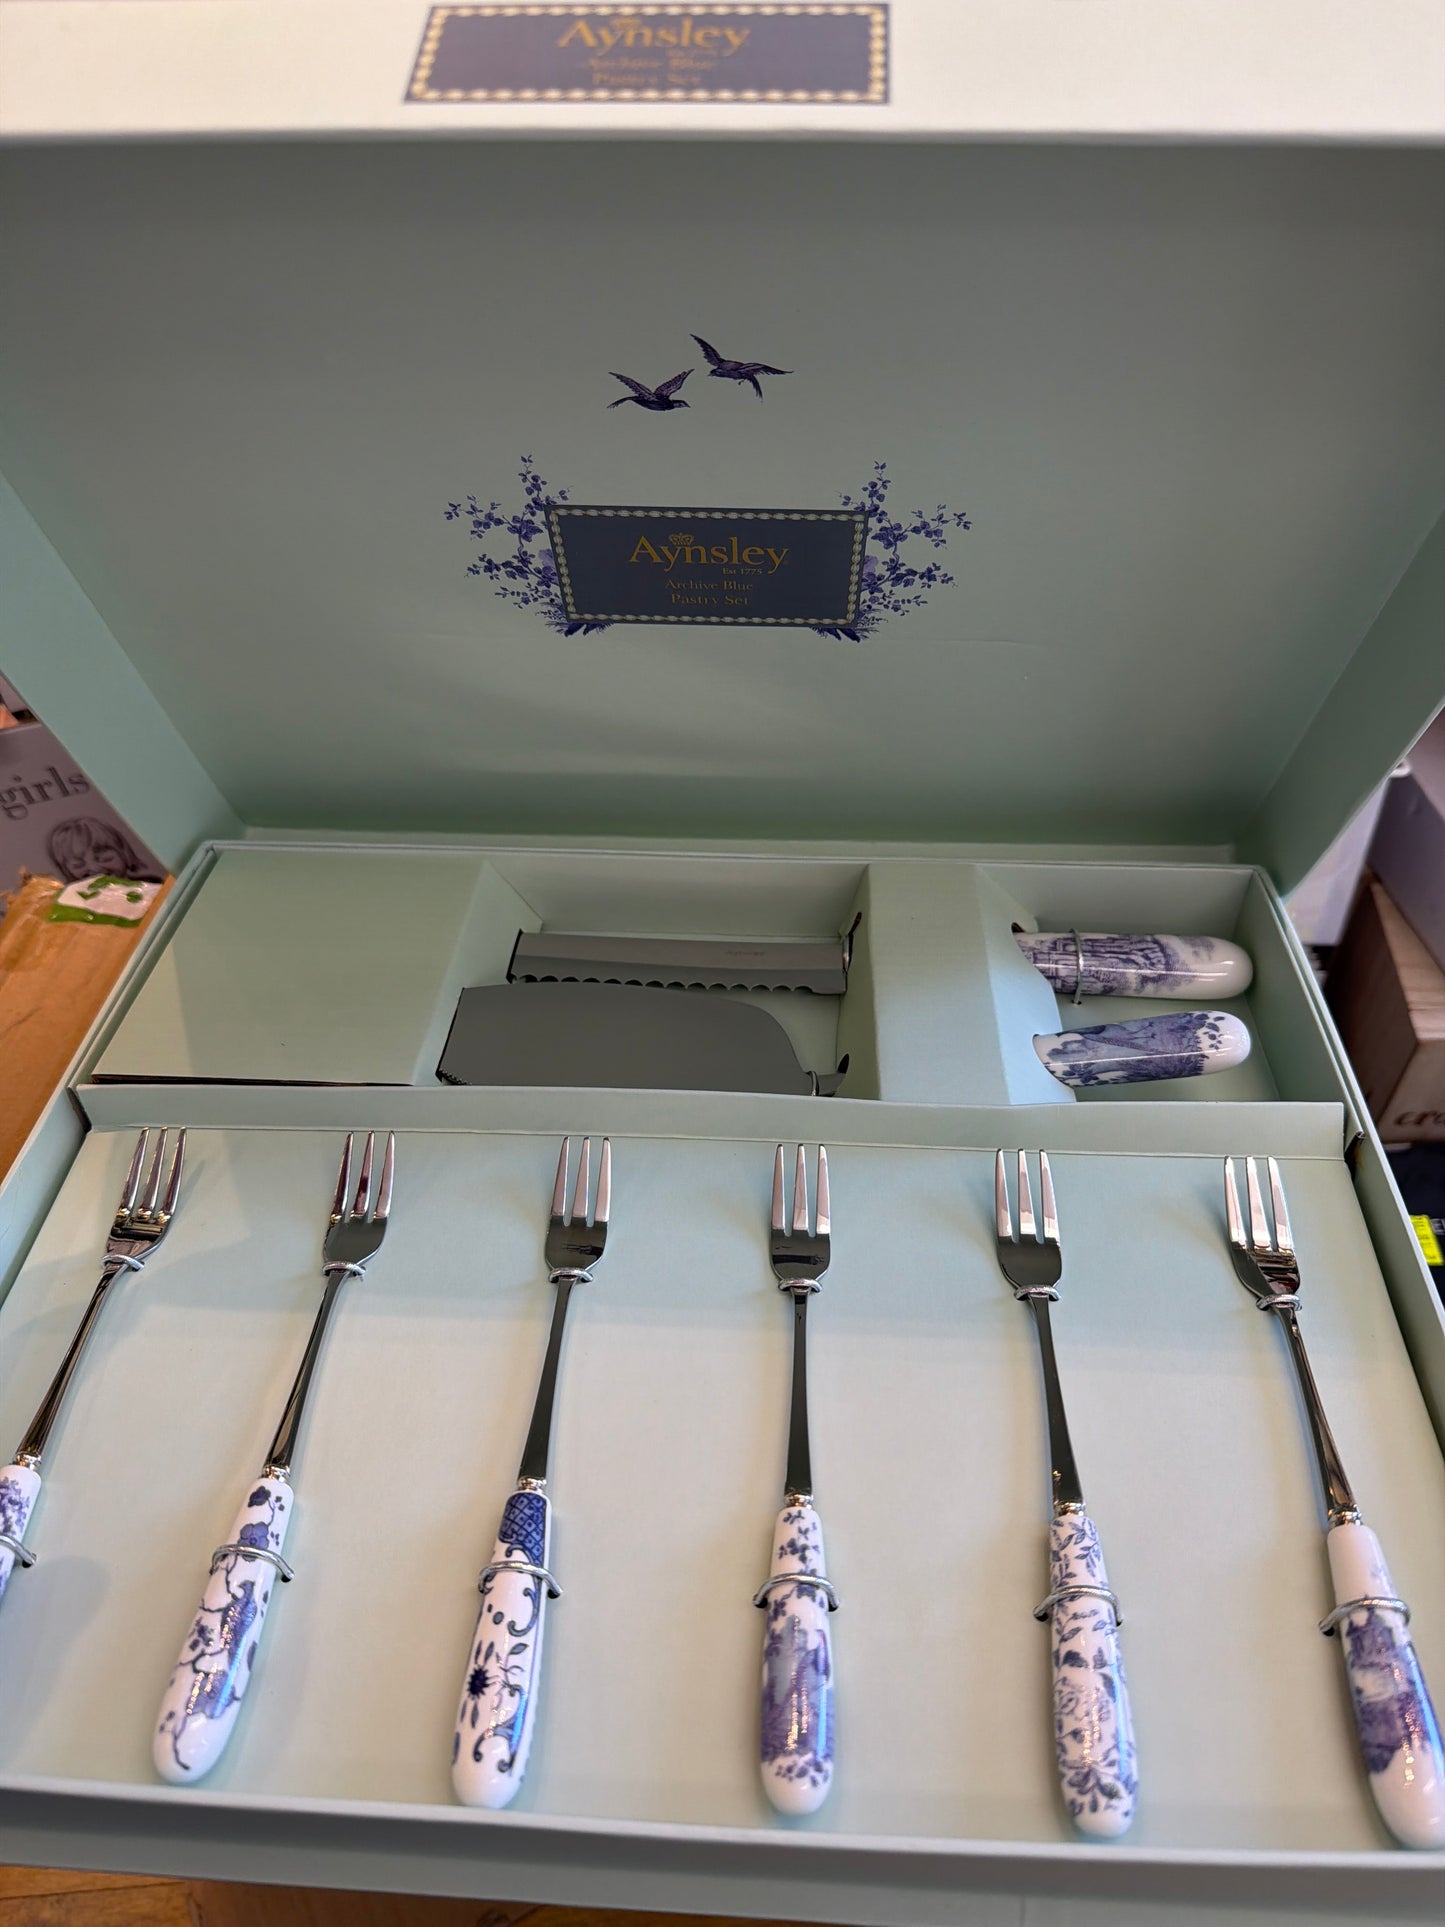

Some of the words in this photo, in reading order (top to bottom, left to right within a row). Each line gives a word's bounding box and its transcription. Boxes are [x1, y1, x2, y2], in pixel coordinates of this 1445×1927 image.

[556, 16, 751, 57] Aynsley
[628, 535, 789, 574] Aynsley
[665, 578, 719, 591] Archive
[723, 580, 753, 591] Blue
[671, 593, 719, 607] Pastry
[724, 595, 750, 606] Set
